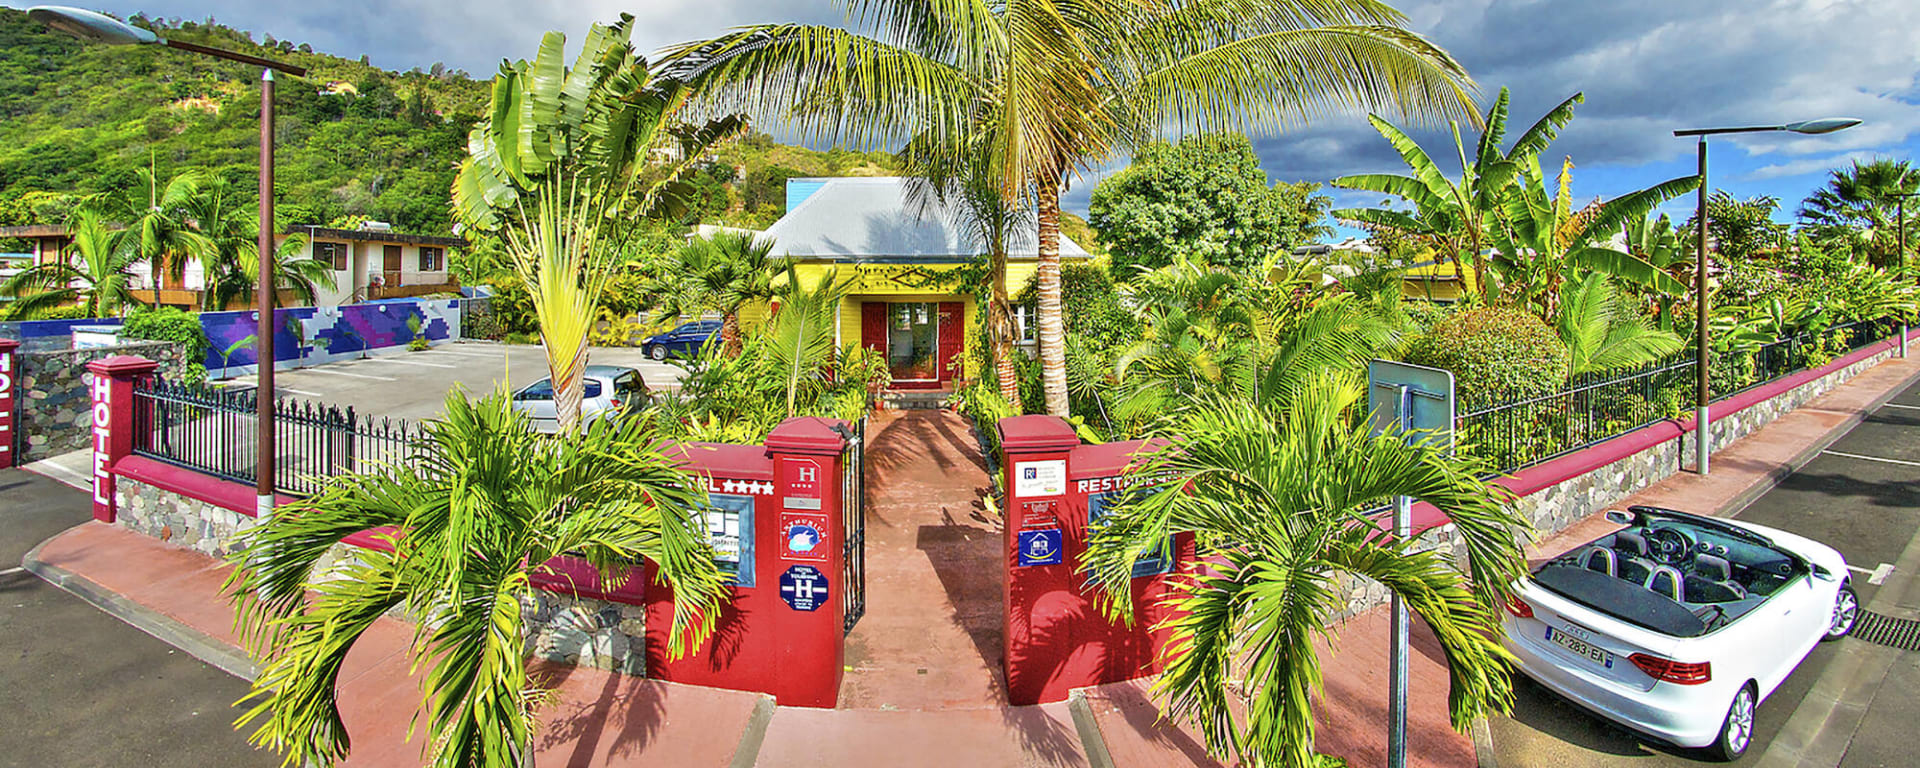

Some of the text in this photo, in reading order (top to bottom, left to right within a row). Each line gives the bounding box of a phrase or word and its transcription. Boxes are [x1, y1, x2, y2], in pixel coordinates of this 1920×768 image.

[94, 376, 111, 506] HOTEL
[799, 467, 815, 482] H
[795, 579, 813, 598] H
